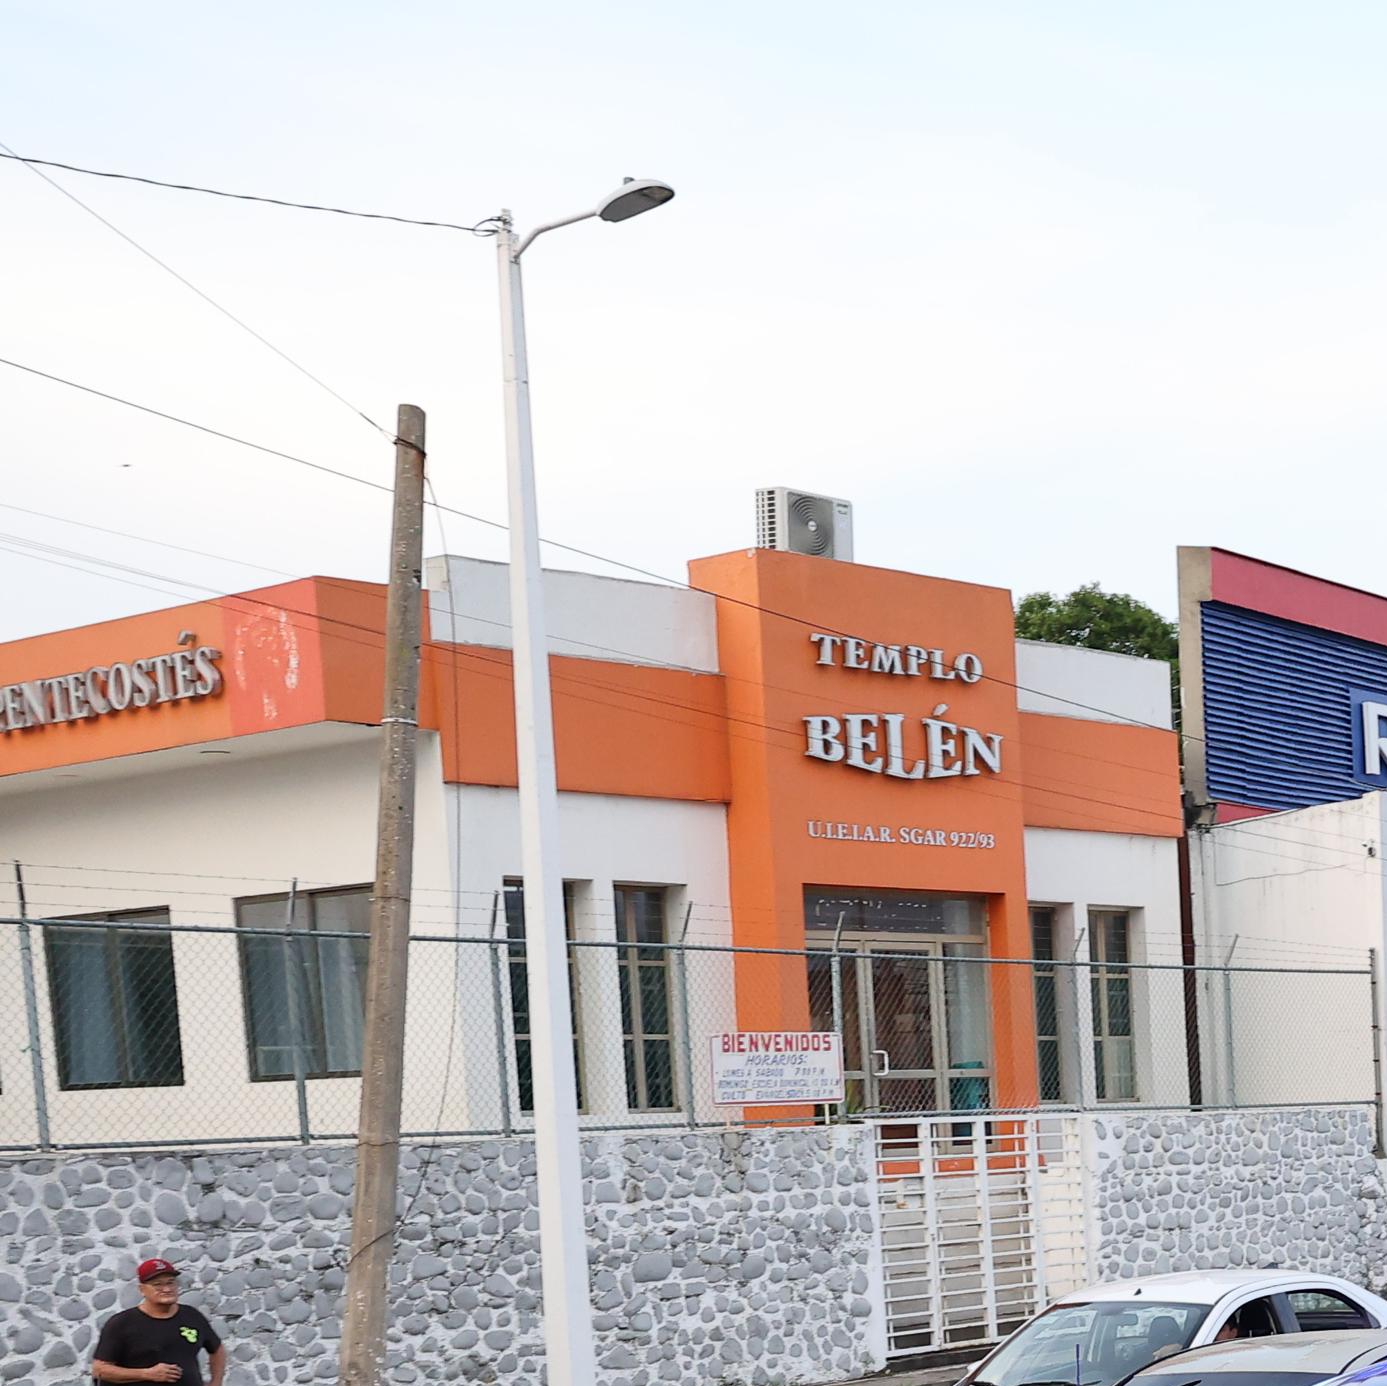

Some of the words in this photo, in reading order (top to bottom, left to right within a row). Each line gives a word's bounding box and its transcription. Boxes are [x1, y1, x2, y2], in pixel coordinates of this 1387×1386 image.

[0, 630, 223, 733] ENTECOSTÉS
[810, 633, 983, 684] TEMPLO
[803, 703, 1003, 779] BELÉN
[807, 821, 896, 843] U.I.E.I.A.R.
[899, 827, 946, 846] SGAR
[950, 831, 996, 849] 922/93
[722, 1034, 832, 1053] BIENVENIDOS
